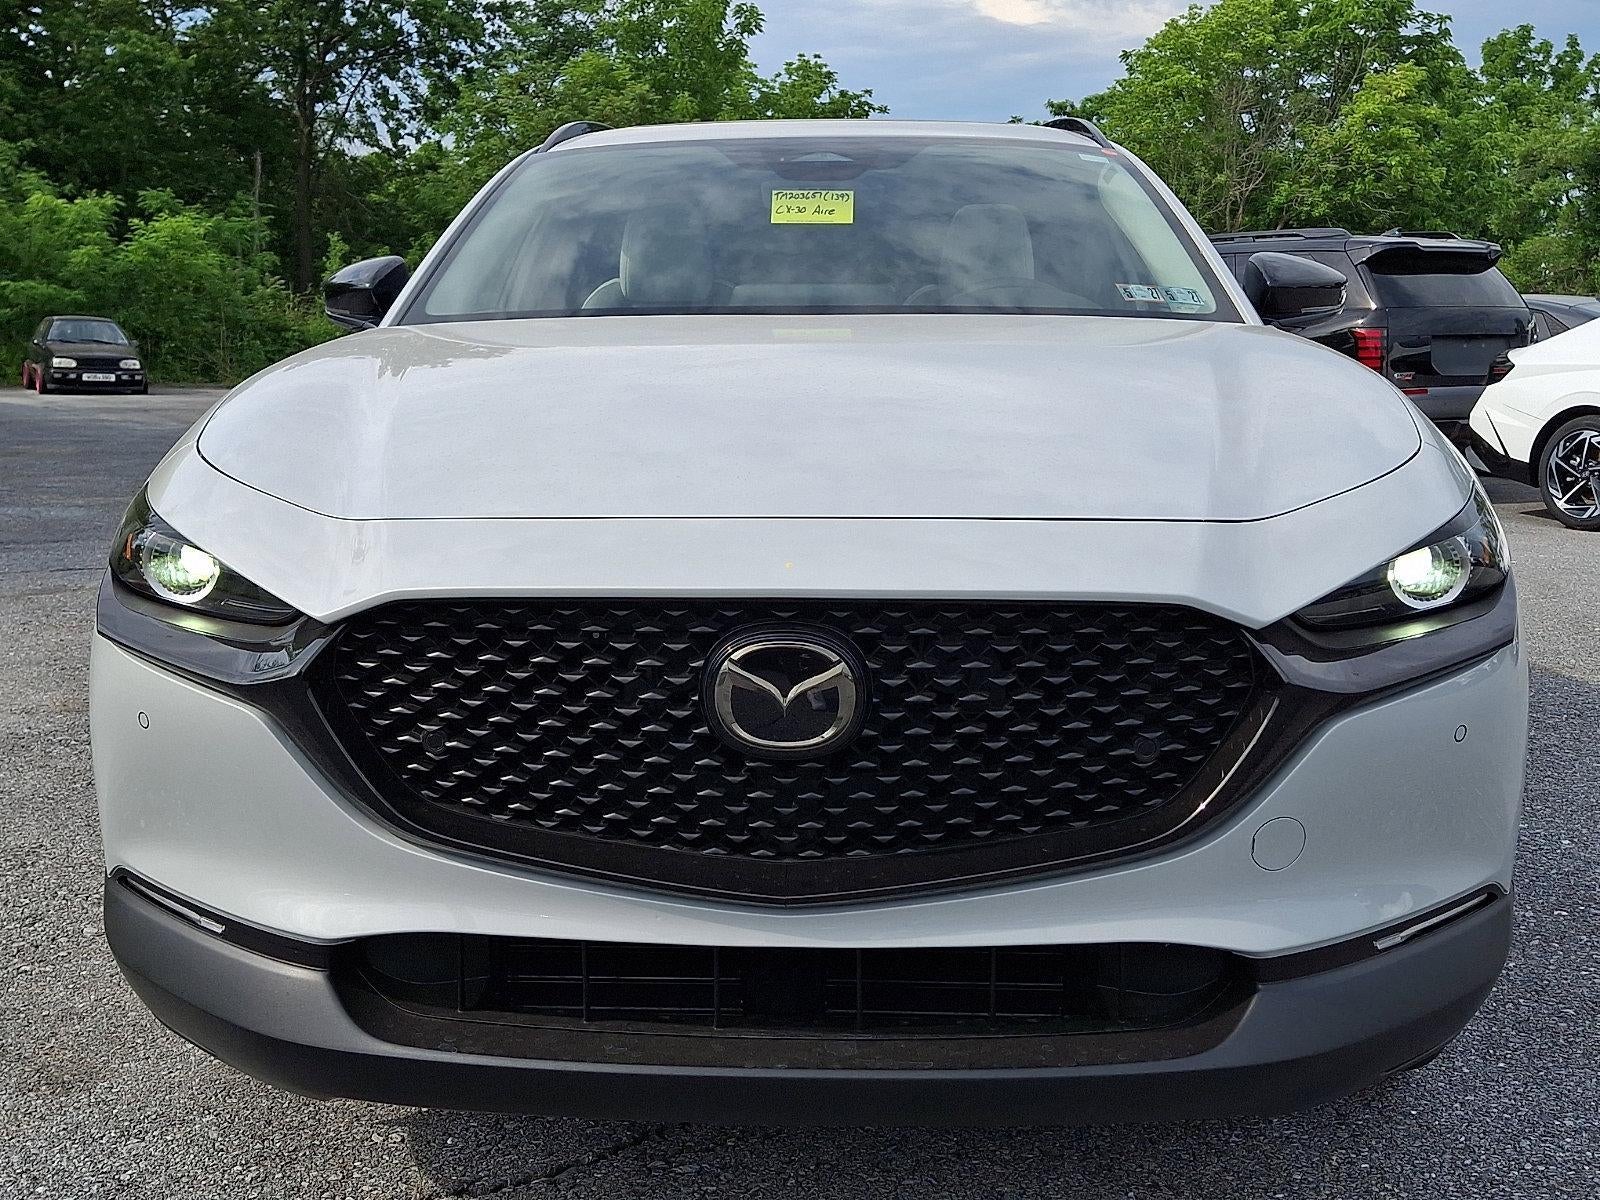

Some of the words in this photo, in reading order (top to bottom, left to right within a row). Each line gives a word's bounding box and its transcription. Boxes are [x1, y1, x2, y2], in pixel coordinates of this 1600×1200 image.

[775, 205, 807, 214] CX-30
[1122, 287, 1133, 299] 5
[1165, 290, 1176, 301] 5
